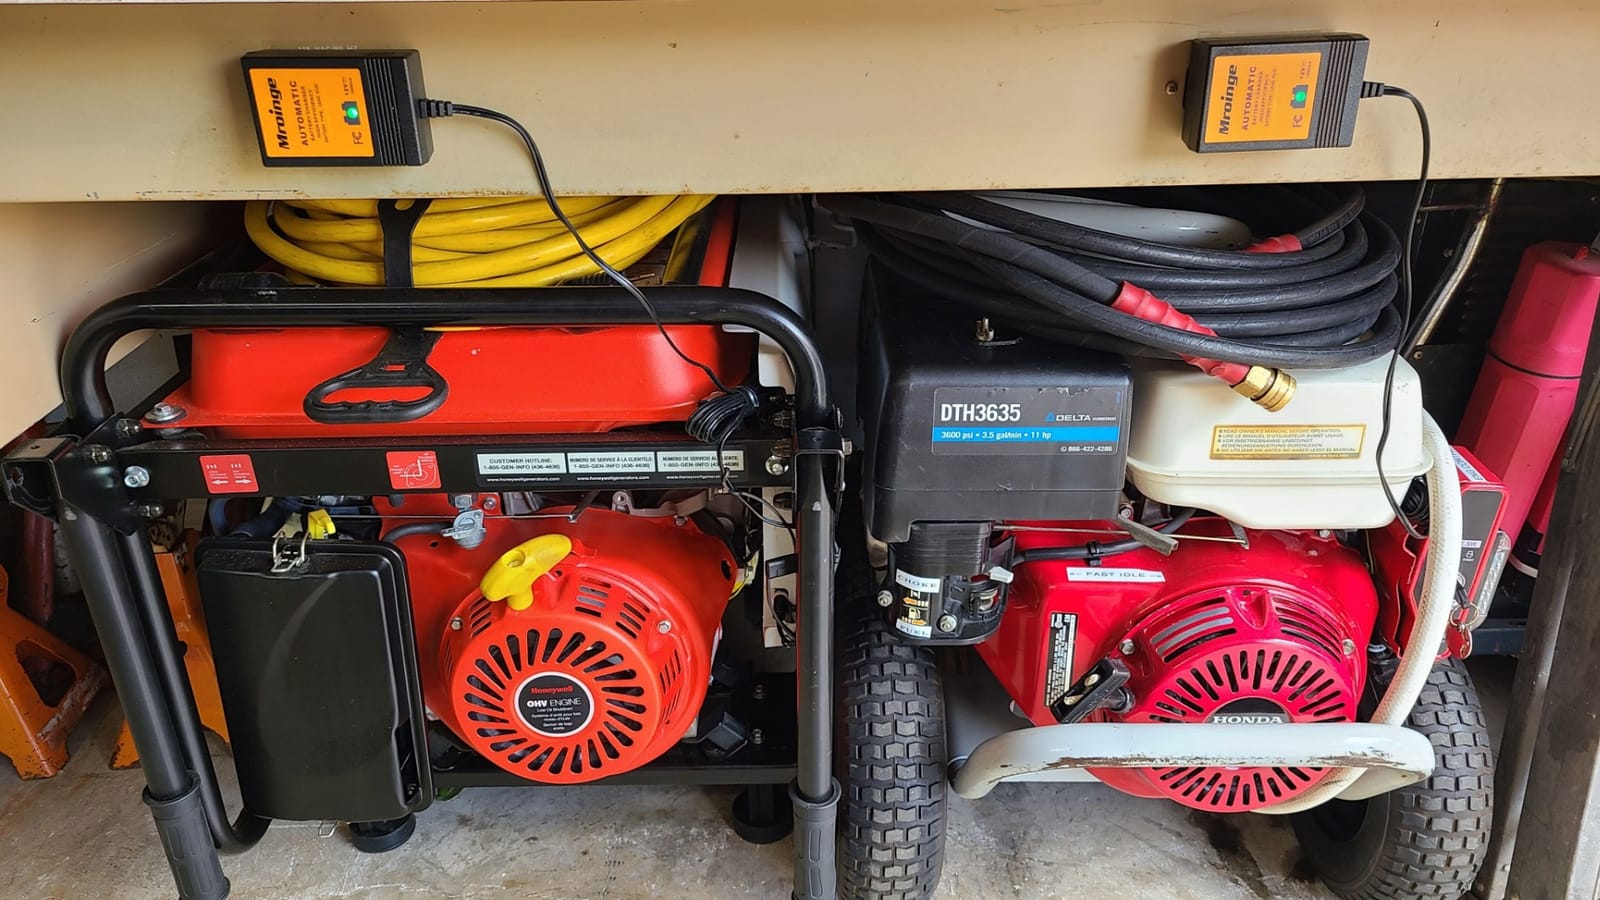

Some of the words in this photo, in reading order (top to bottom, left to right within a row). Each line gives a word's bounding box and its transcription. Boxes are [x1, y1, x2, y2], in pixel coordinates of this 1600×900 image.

[1218, 64, 1239, 135] Mroinge
[1242, 66, 1257, 131] AUTOMATIC
[267, 78, 290, 150] Mroinge
[289, 81, 309, 147] AUTOMATIC
[941, 403, 1021, 422] DTH3635
[1056, 414, 1092, 422] DELTA
[941, 431, 960, 439] 3600
[962, 431, 973, 441] psi
[982, 431, 994, 439] 3.5
[996, 431, 1022, 441] gal/min
[1032, 431, 1040, 439] 11
[1042, 431, 1052, 441] hp
[898, 573, 937, 588] CHOKE
[531, 685, 573, 694] Honeywell
[527, 699, 548, 708] OHV
[549, 697, 582, 706] ENGINE
[1212, 716, 1283, 724] HONDA
